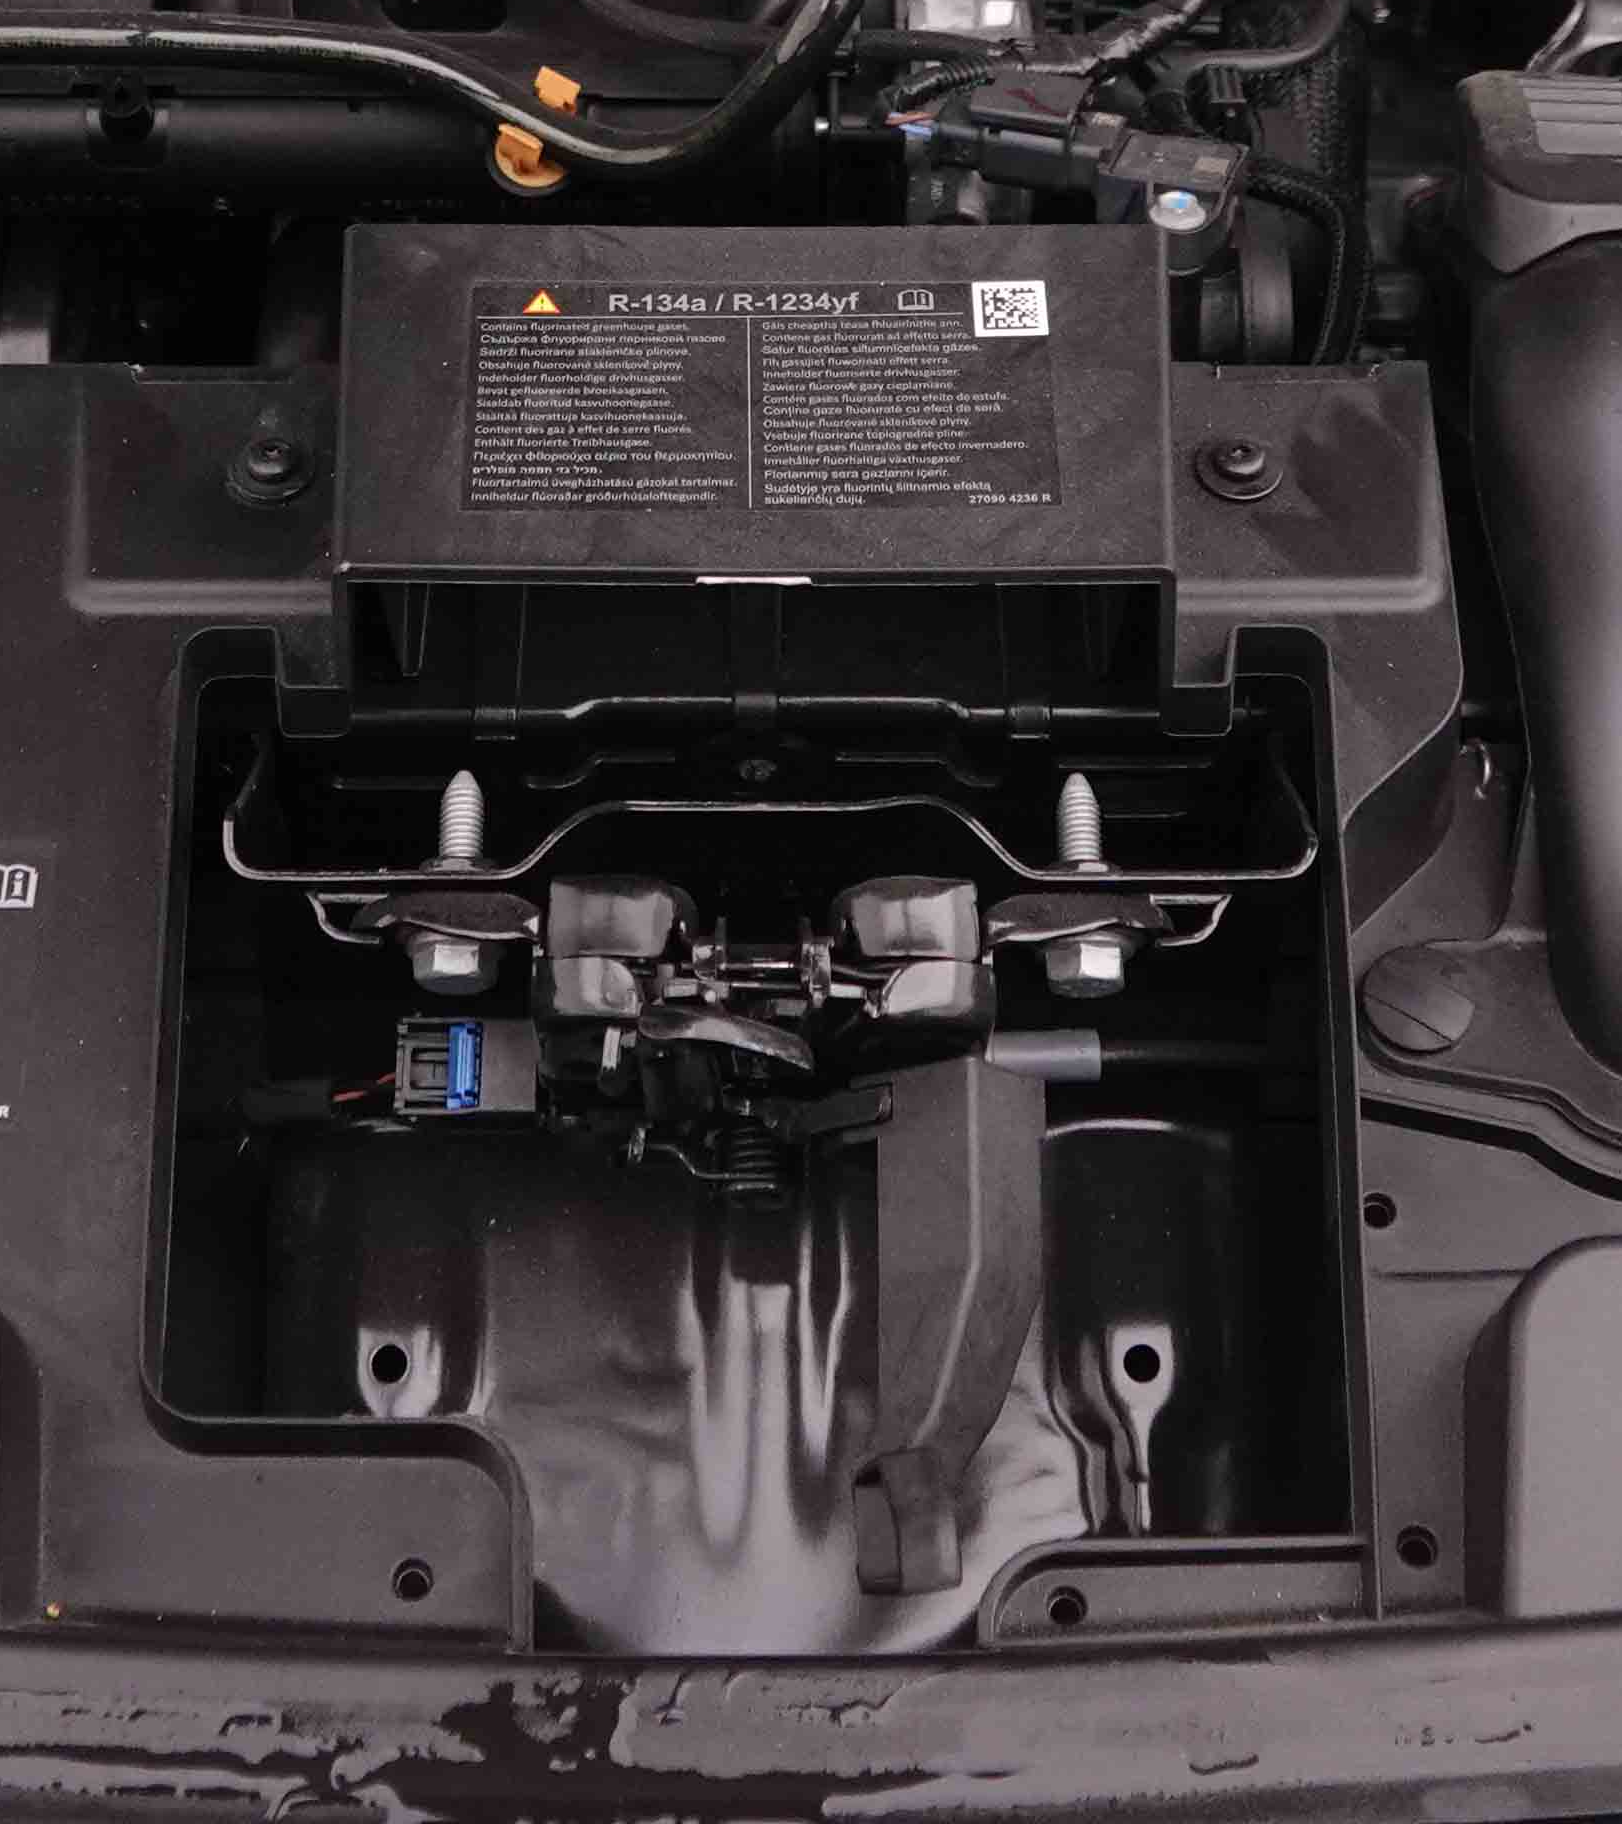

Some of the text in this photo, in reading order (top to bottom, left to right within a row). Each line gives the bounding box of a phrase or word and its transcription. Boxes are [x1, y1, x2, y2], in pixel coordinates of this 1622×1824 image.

[608, 291, 707, 313] R-134a
[732, 290, 861, 316] R-1234yf
[481, 322, 528, 331] Contains
[479, 360, 530, 371] Obsahuje
[524, 425, 544, 434] des
[606, 425, 620, 434] de
[1042, 493, 1052, 503] R
